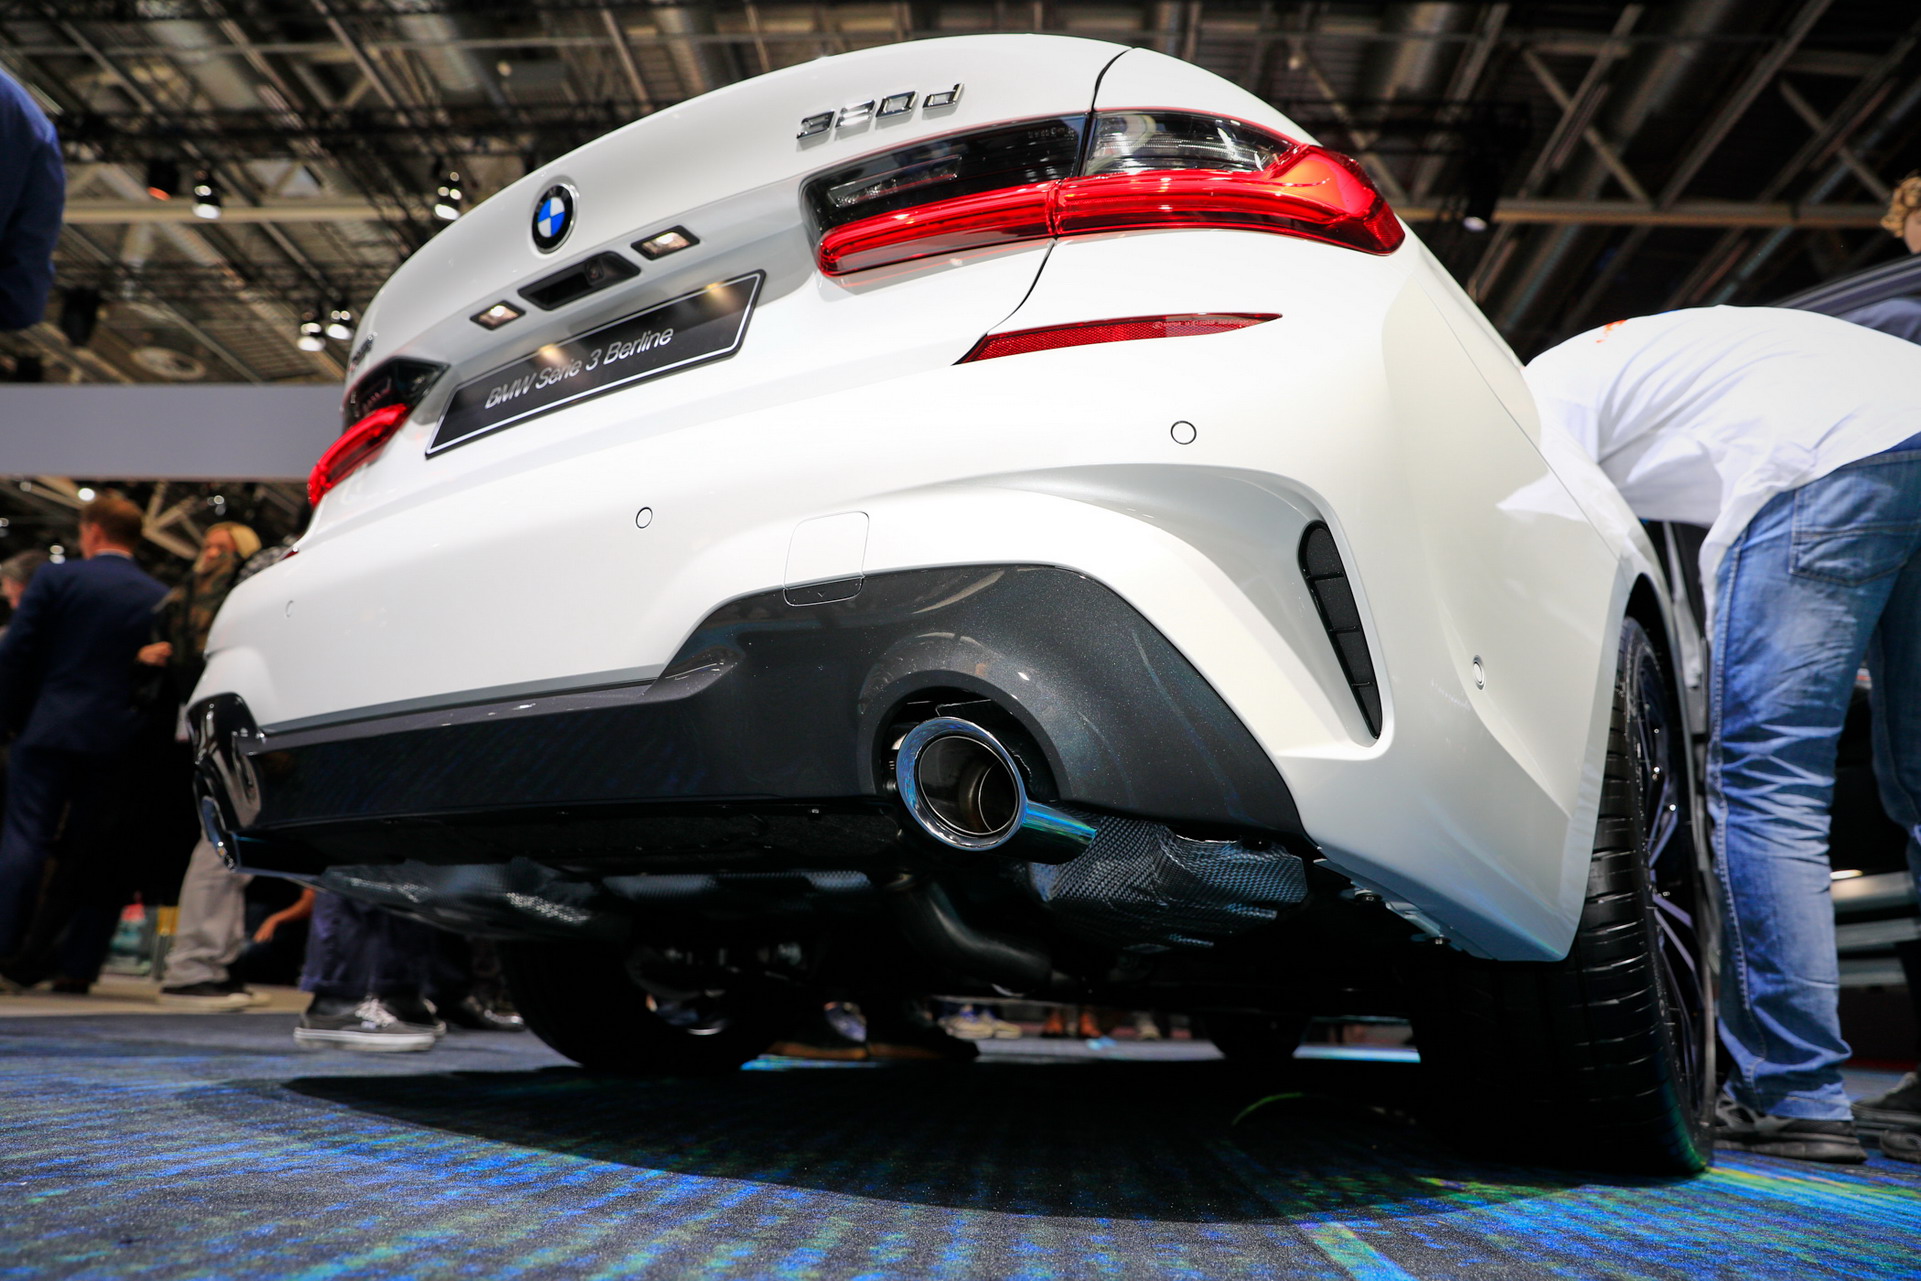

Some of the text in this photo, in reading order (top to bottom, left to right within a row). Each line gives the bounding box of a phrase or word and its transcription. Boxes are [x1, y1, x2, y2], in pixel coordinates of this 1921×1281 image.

[796, 82, 965, 140] 320d
[484, 327, 675, 410] BMW Serie 3 Berline
